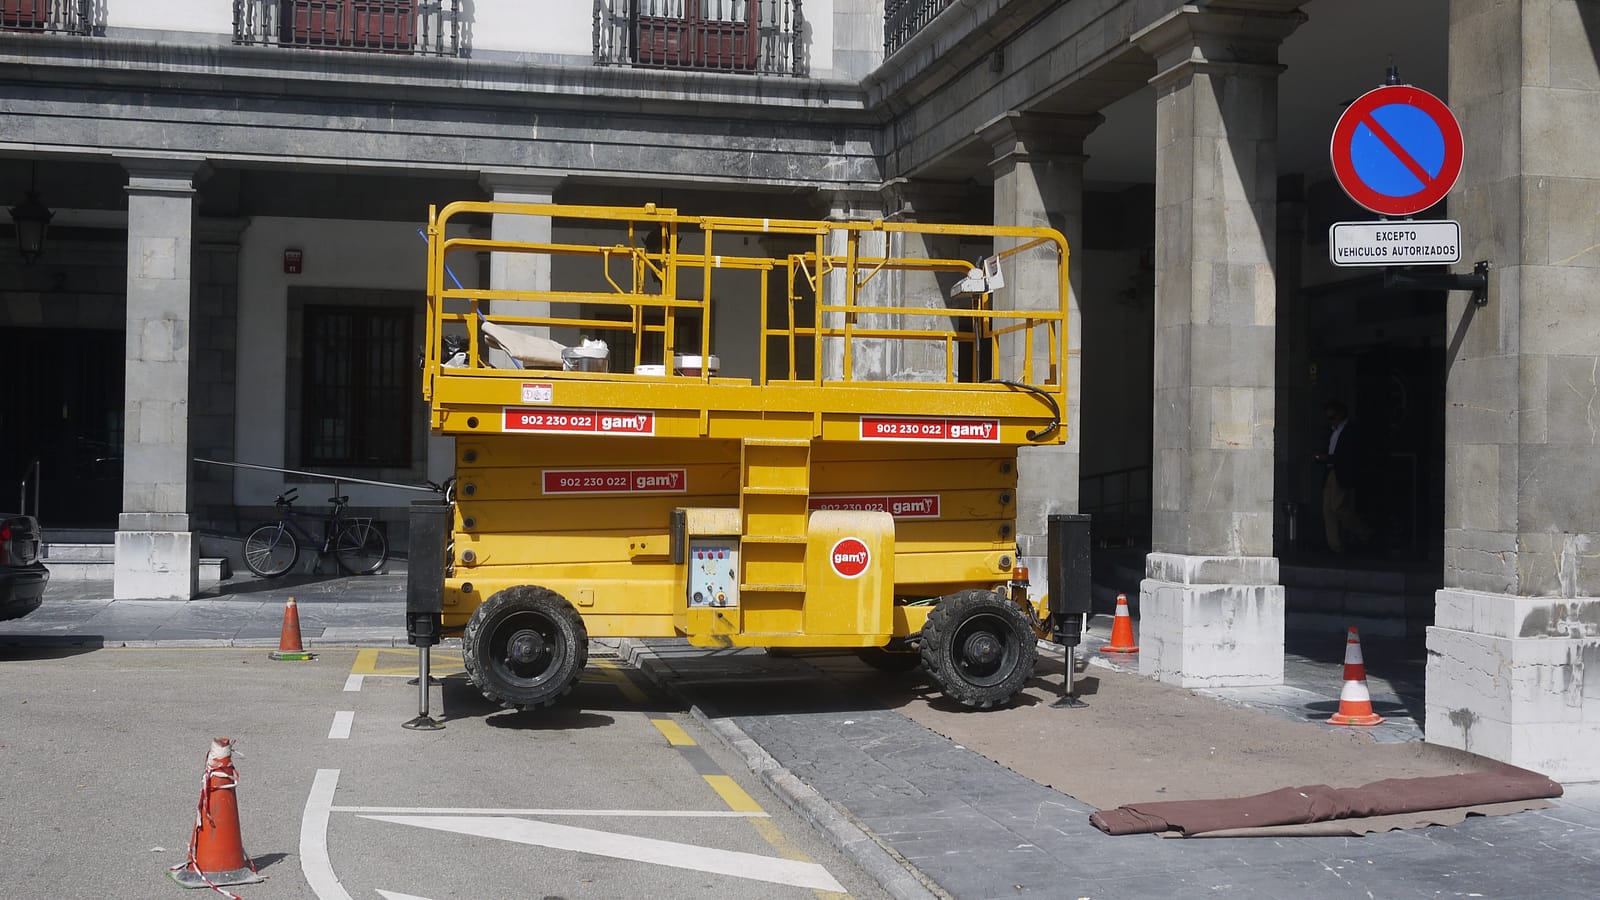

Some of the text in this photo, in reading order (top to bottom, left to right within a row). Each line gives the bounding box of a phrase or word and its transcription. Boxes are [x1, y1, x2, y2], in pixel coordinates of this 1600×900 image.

[1376, 231, 1417, 241] EXCEPTO
[1338, 245, 1455, 257] VEHICULOS AUTORIZADOS
[521, 415, 543, 425] 902
[546, 416, 567, 426] 230
[570, 416, 592, 426] 022
[877, 424, 897, 433] 902
[899, 424, 919, 434] 230
[922, 425, 942, 434] 022
[560, 478, 581, 487] 902
[583, 478, 604, 486] 230
[606, 477, 626, 486] 022
